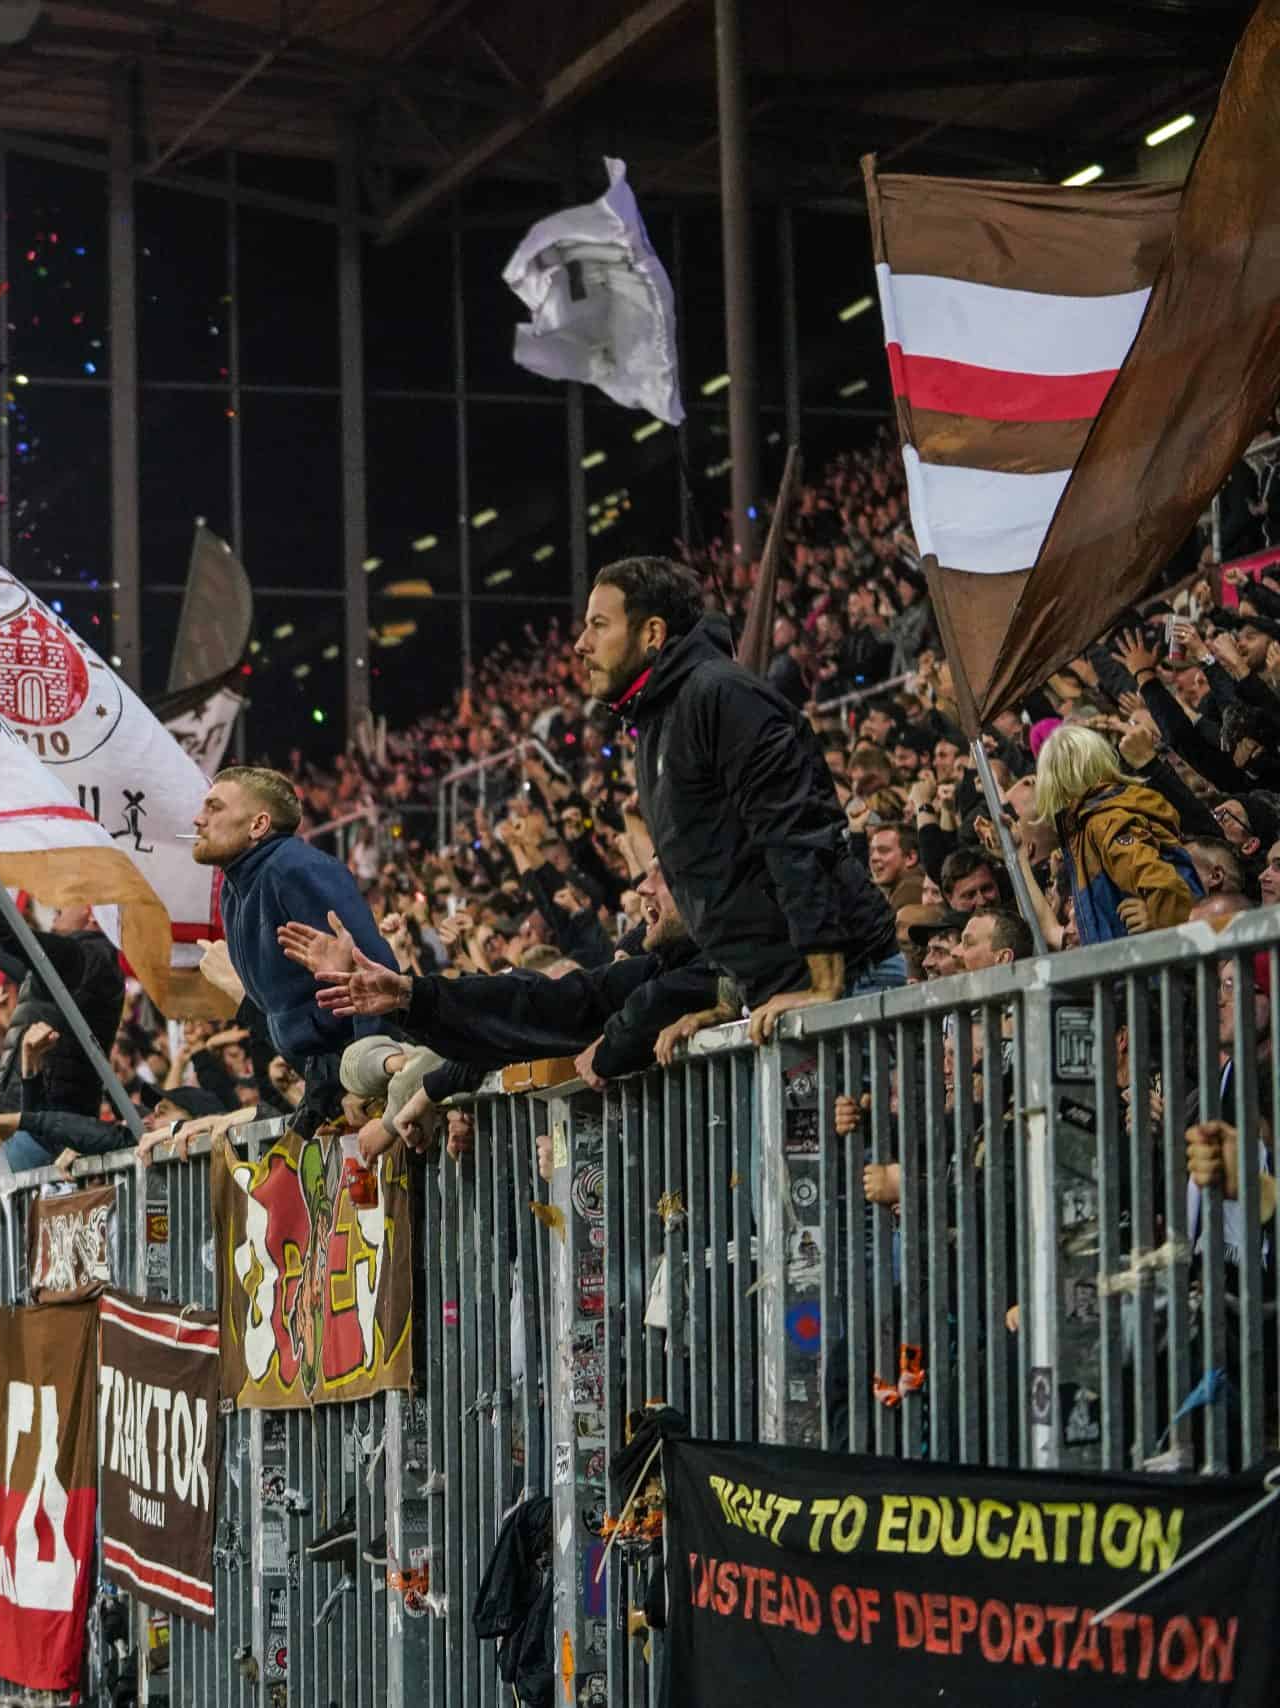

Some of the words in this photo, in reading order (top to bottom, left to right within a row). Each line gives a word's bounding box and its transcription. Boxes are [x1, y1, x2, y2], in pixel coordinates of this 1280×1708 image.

[97, 1365, 210, 1513] TRAKTOR
[808, 1494, 868, 1552] TO
[876, 1494, 1184, 1573] EDUCATION
[688, 1552, 821, 1636] INSTEAD
[831, 1584, 880, 1646] OF
[893, 1590, 1239, 1684] DEPORTATION
